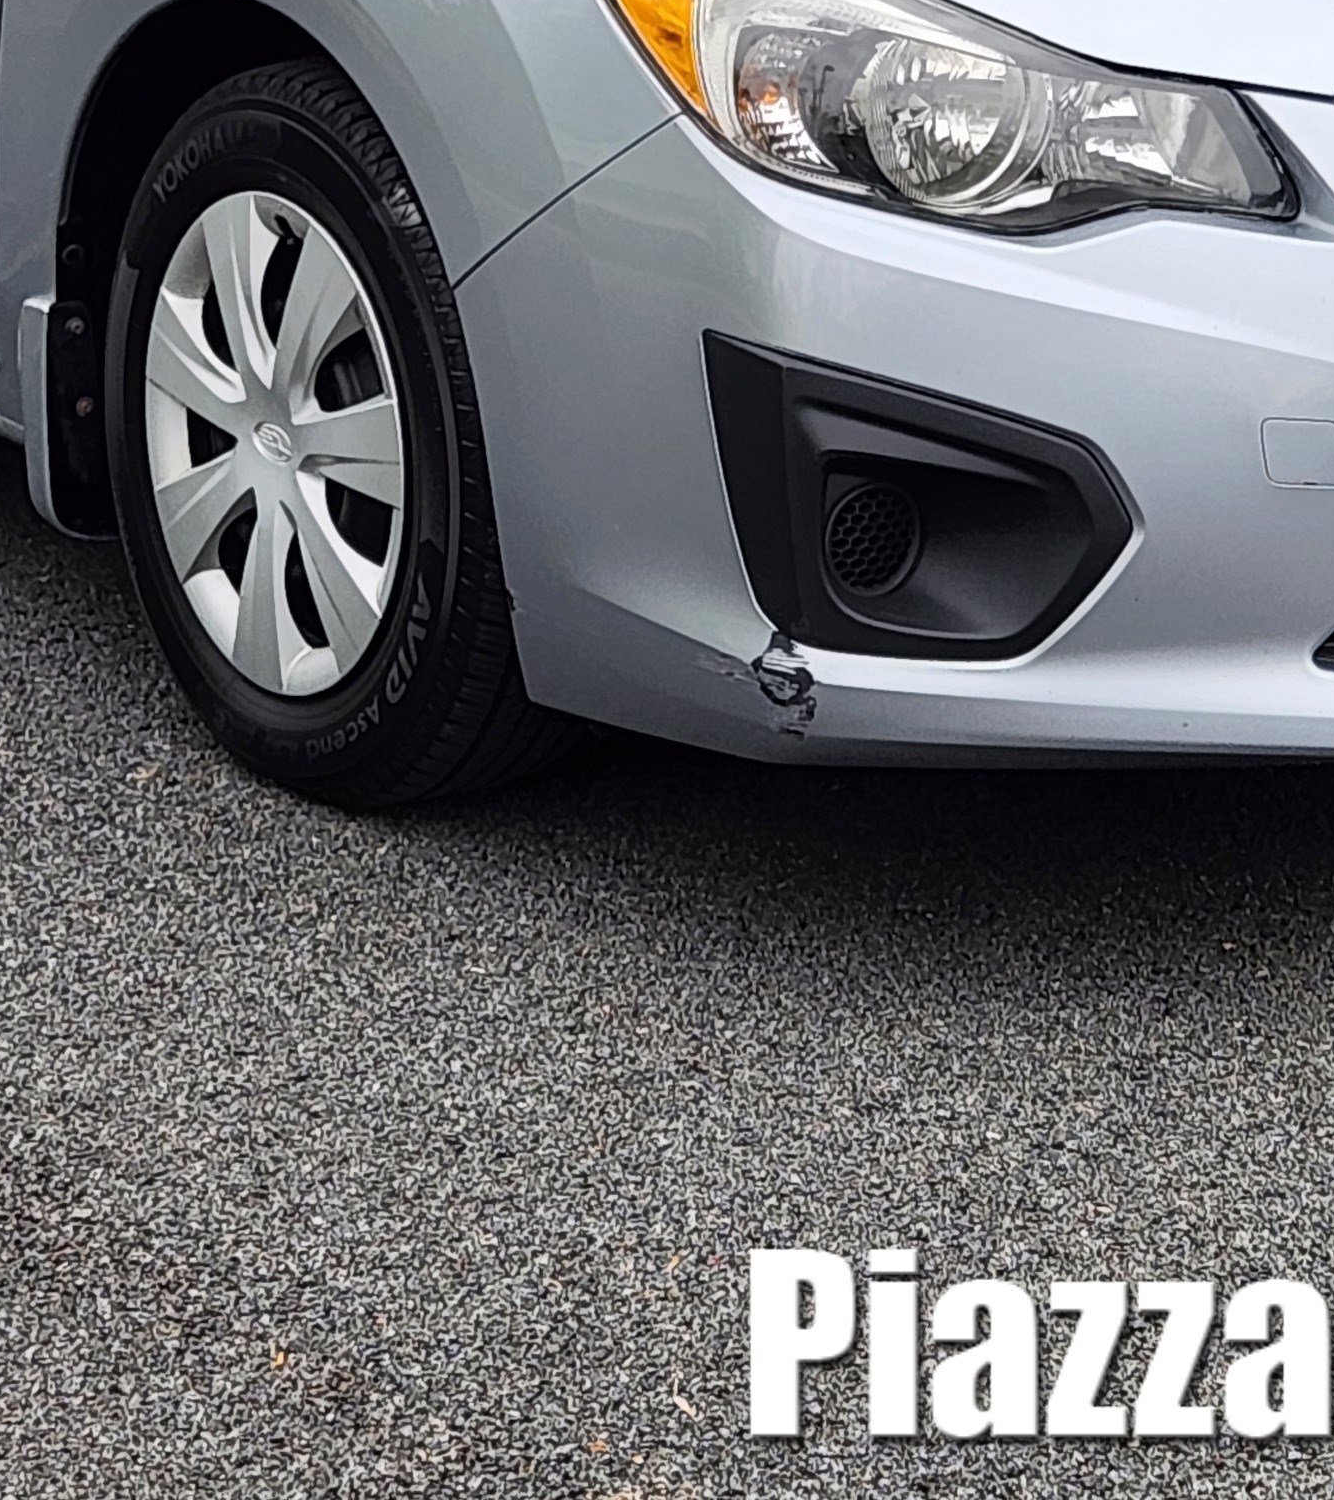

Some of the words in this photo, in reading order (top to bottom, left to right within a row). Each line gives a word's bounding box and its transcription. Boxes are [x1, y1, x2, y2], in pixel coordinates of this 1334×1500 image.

[152, 119, 242, 204] YOKOHA
[385, 570, 432, 705] AVID
[306, 694, 381, 764] Ascend
